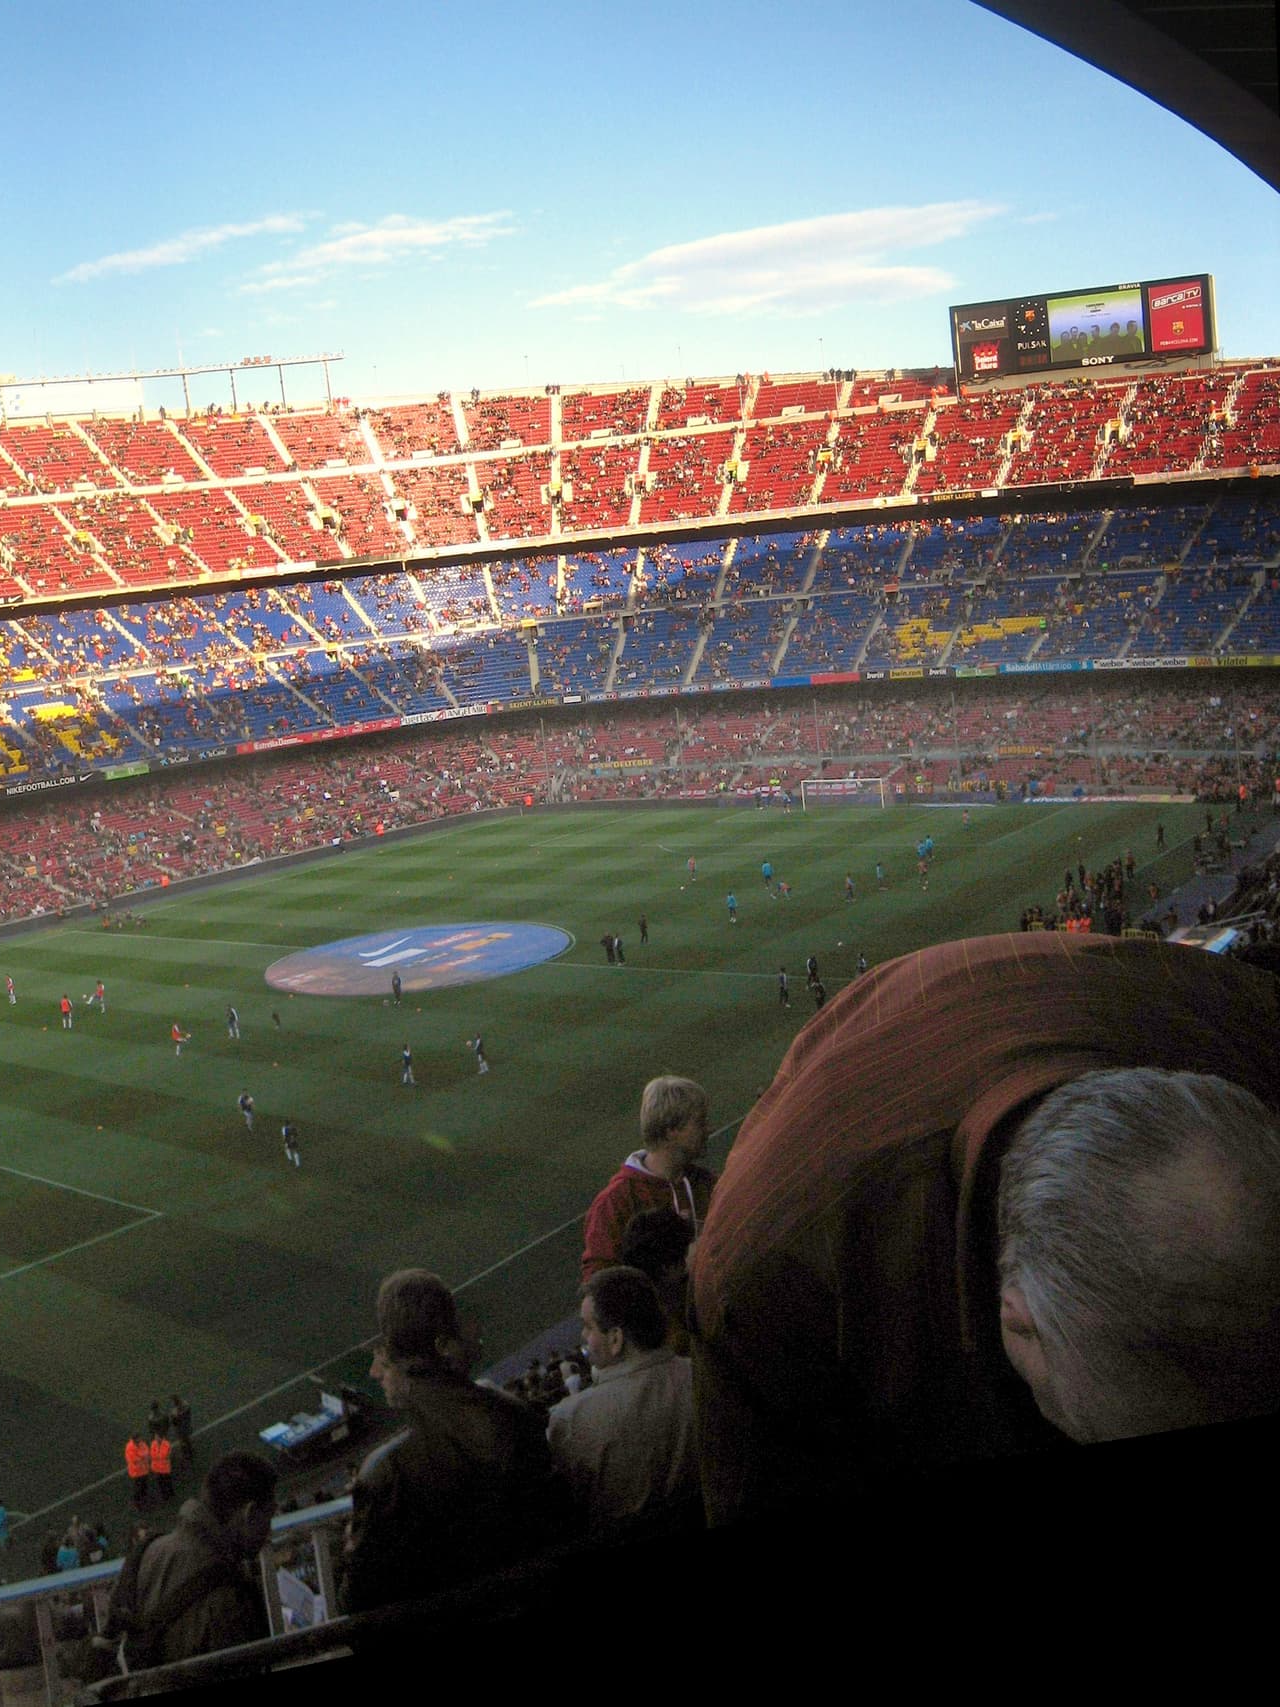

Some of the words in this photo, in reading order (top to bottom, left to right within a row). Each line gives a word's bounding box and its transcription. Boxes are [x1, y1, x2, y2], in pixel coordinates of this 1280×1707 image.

[1017, 340, 1047, 350] PULSAR
[1081, 355, 1115, 366] SONY
[1099, 659, 1124, 668] weber
[1131, 659, 1157, 667] weber
[1162, 658, 1187, 667] weber
[6, 775, 76, 796] NIKEFOOTBALL.COM
